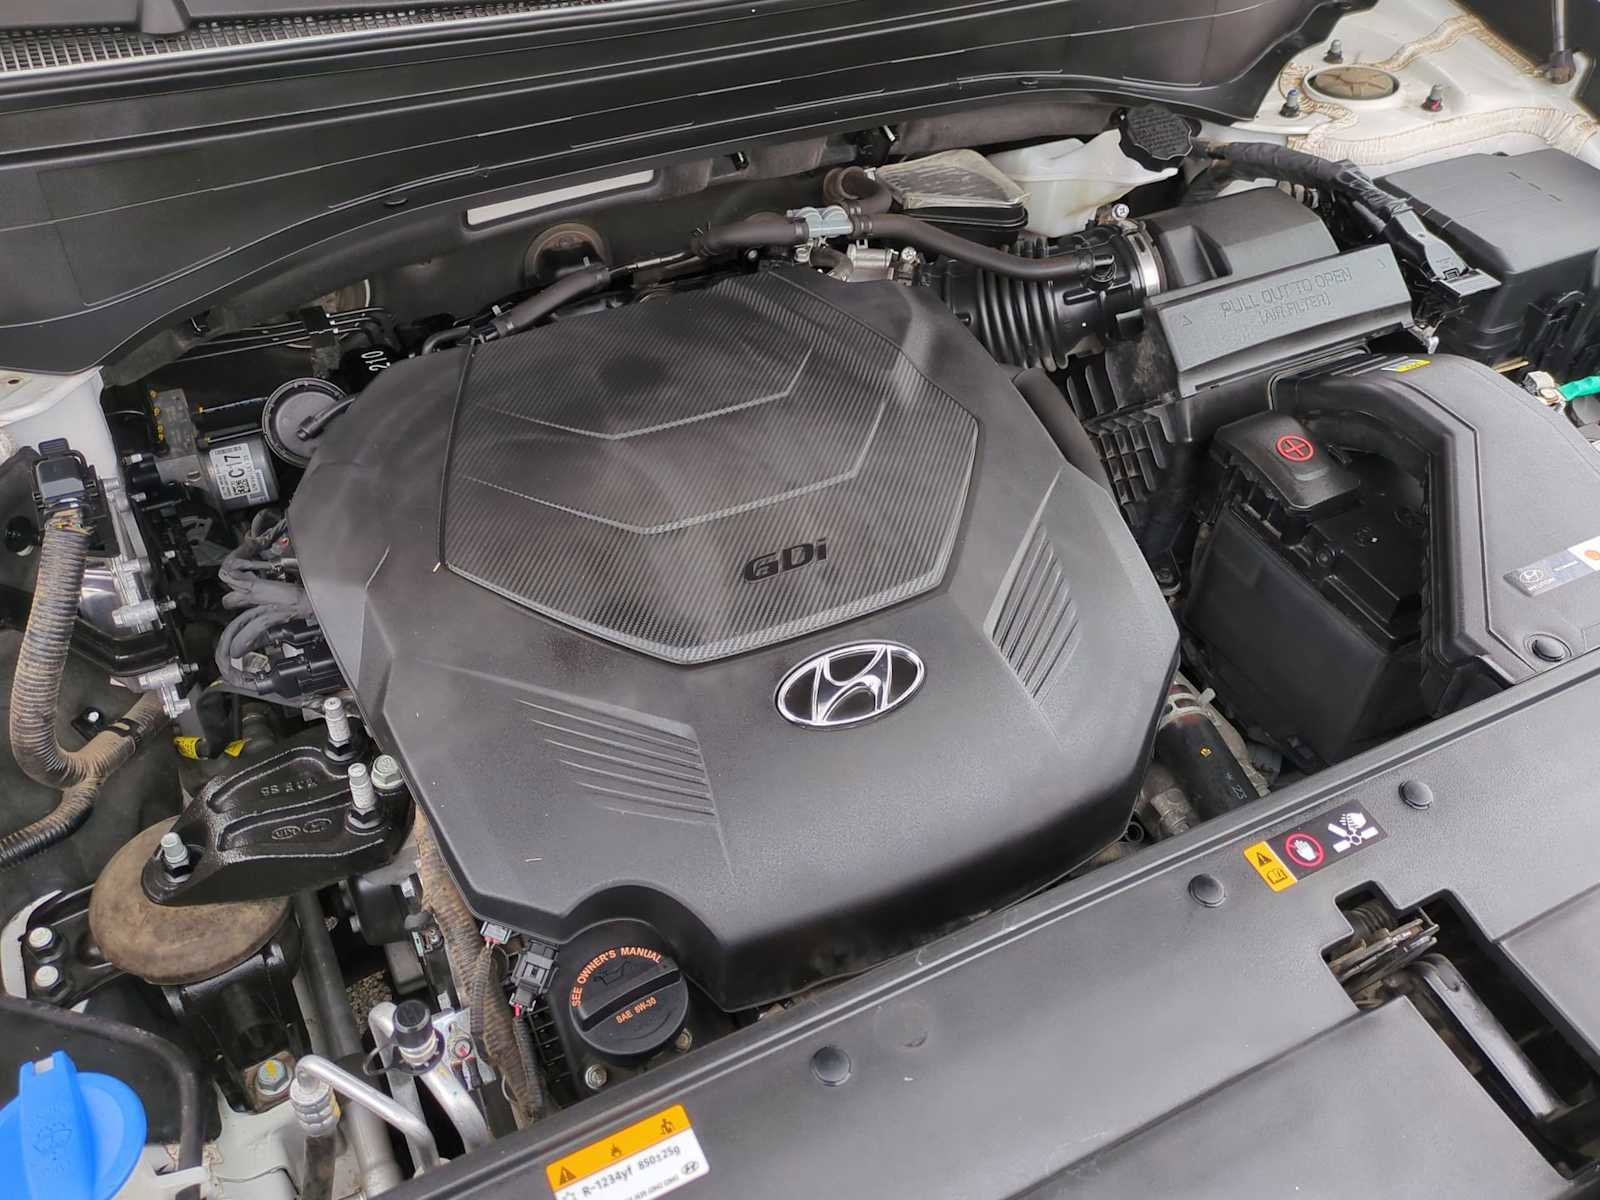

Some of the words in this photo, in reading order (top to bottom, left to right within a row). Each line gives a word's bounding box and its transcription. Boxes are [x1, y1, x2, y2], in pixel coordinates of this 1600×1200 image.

[1220, 293, 1260, 318] PULL
[1261, 284, 1290, 304] OUT
[1314, 267, 1353, 288] OPEN
[576, 949, 618, 985] OWNER'S
[619, 946, 663, 964] MANUAL
[570, 986, 584, 1008] SEE
[581, 1165, 634, 1197] R-1234yf
